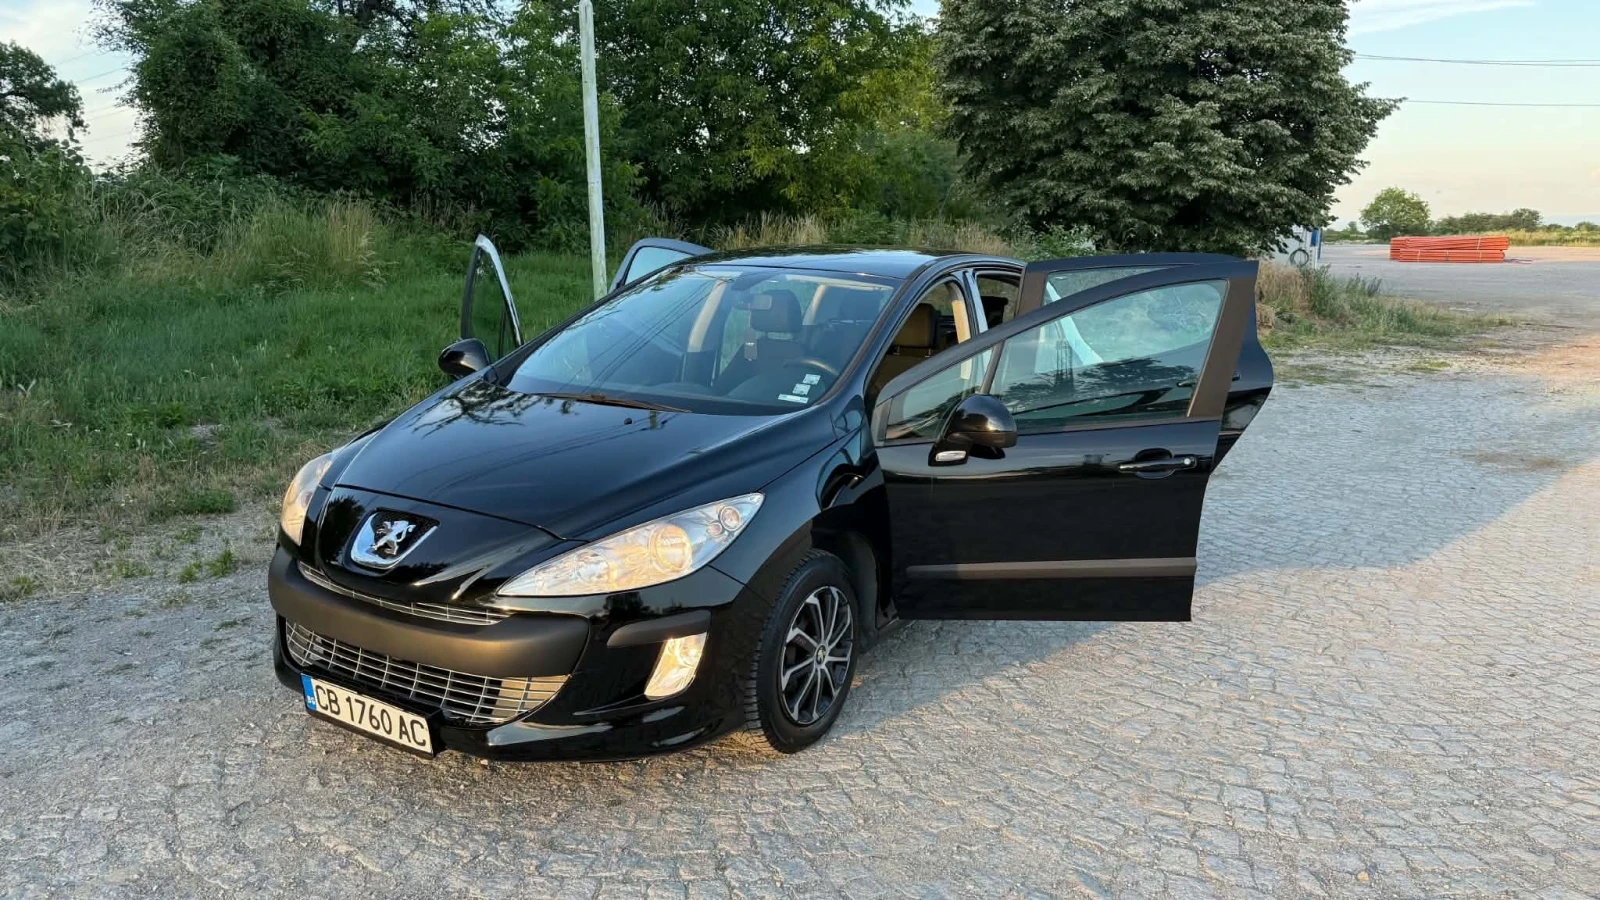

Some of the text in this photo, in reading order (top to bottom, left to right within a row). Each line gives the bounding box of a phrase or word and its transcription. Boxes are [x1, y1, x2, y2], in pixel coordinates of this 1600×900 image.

[315, 685, 426, 746] CB 1760 AC
